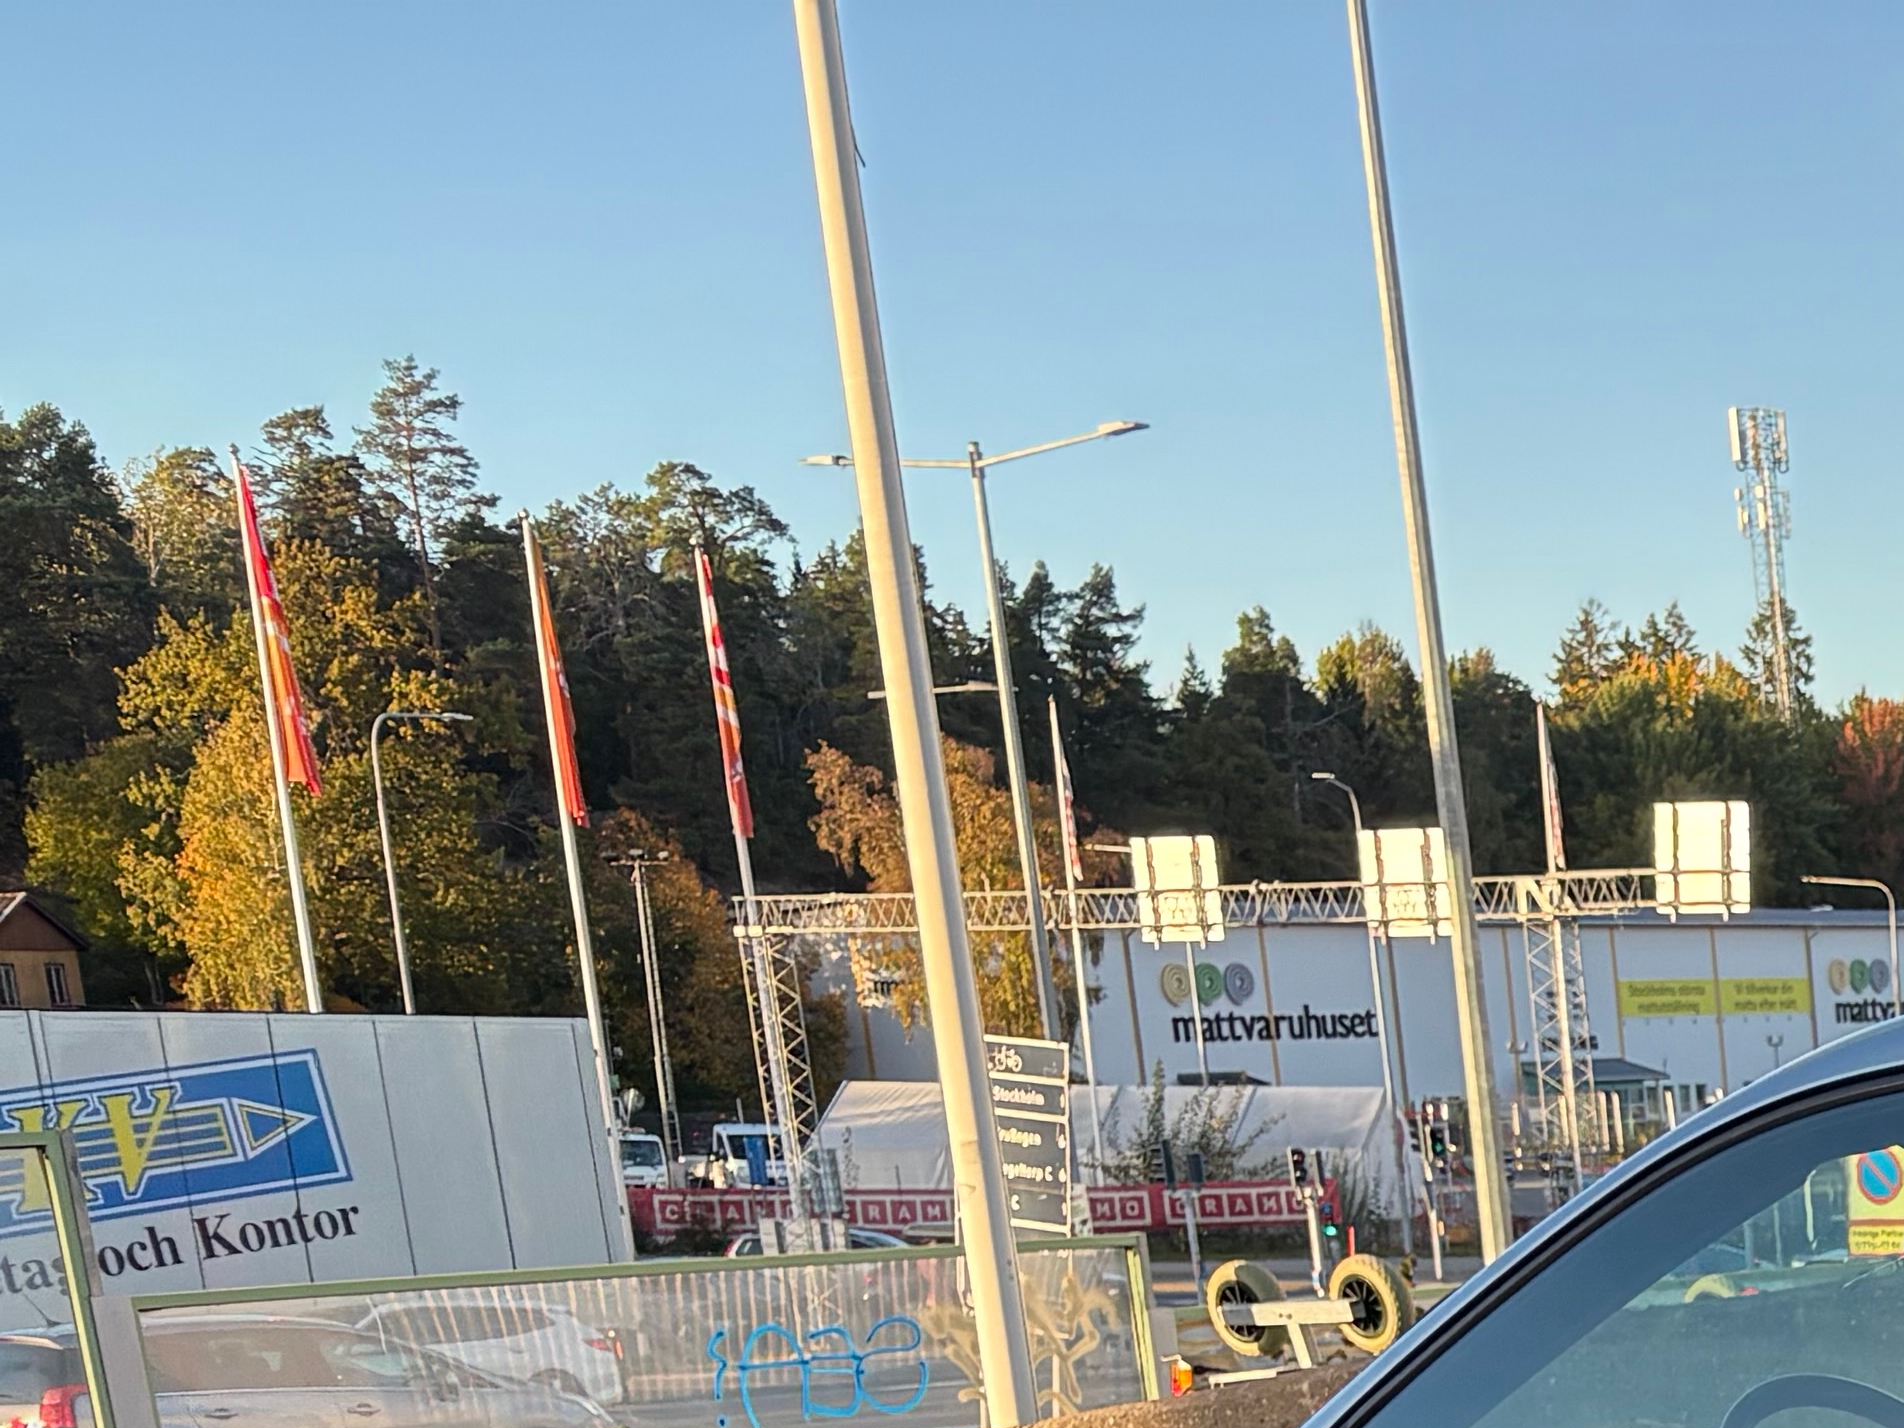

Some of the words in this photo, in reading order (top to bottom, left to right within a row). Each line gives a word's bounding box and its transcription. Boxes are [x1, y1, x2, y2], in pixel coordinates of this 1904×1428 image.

[1171, 1003, 1380, 1044] mattvaruhuset
[97, 1226, 184, 1277] och
[193, 1205, 360, 1262] Kontor
